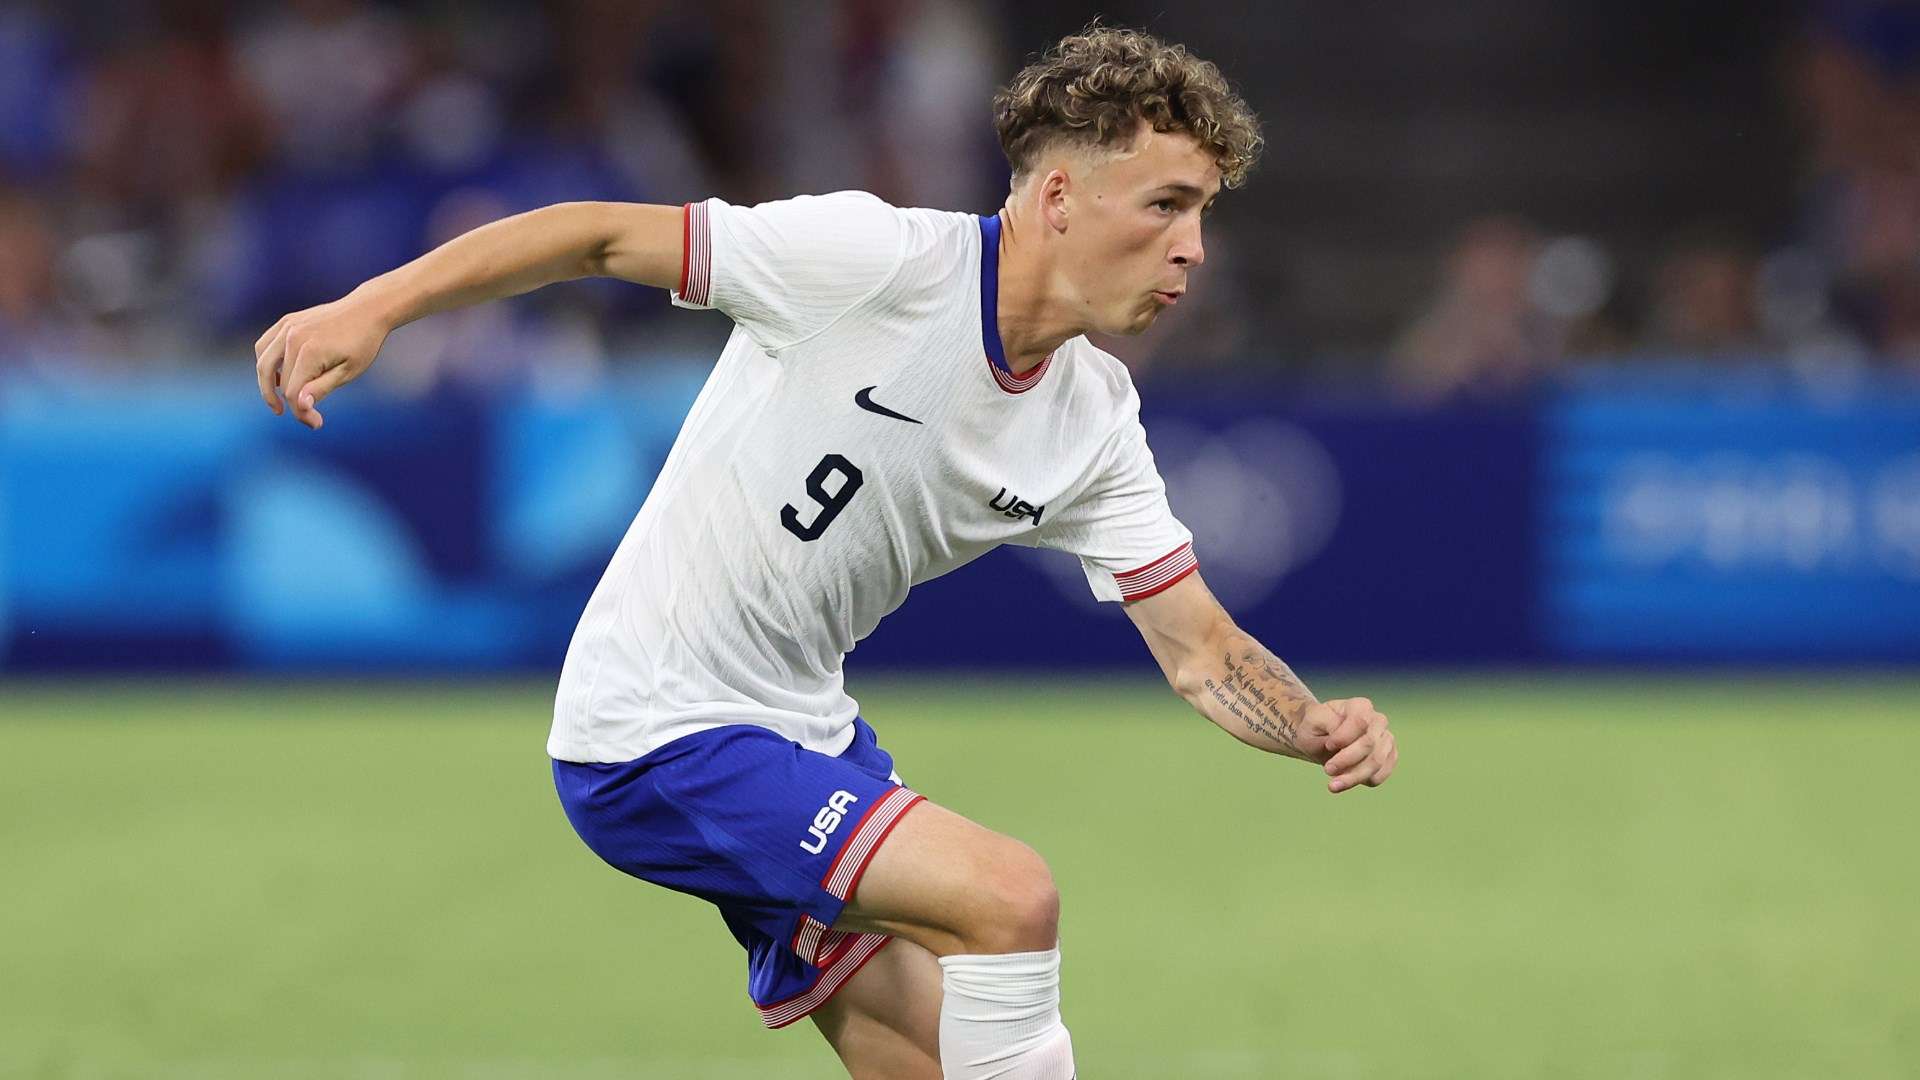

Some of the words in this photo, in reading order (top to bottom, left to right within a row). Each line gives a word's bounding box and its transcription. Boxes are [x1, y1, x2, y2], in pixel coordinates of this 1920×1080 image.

[780, 454, 864, 542] 9
[988, 487, 1046, 526] USA
[1204, 679, 1213, 693] are
[799, 790, 858, 855] USA
